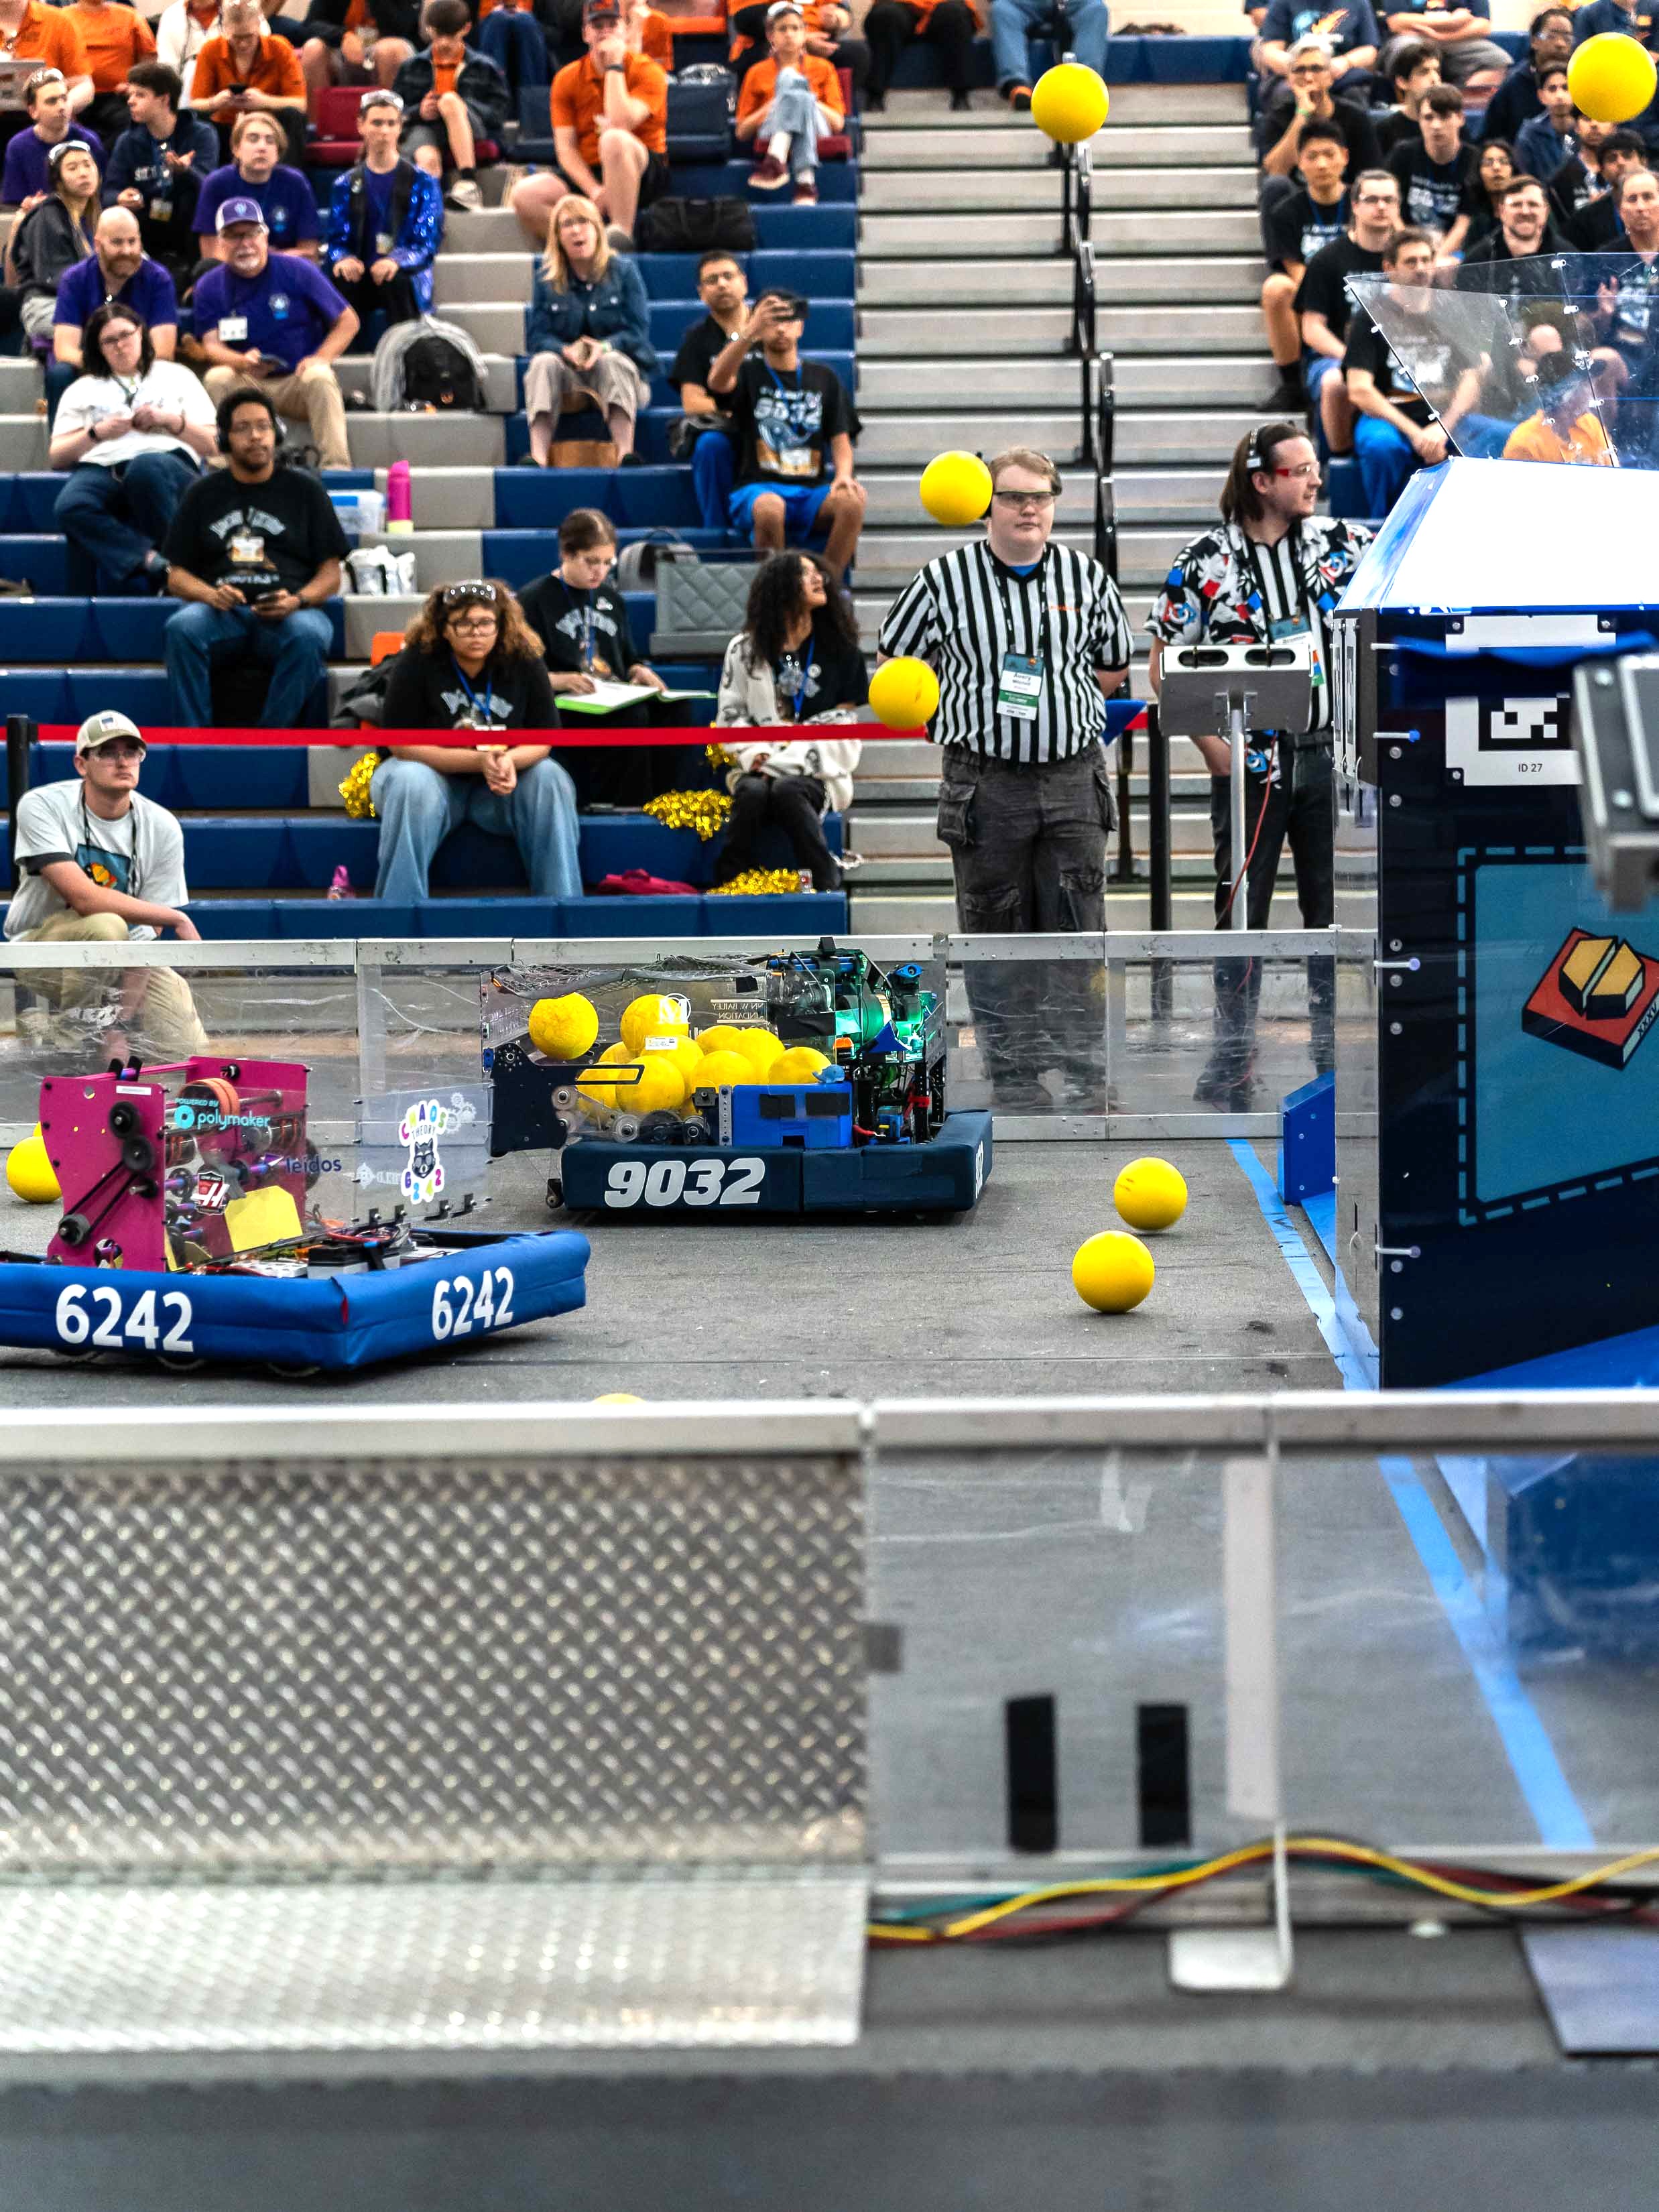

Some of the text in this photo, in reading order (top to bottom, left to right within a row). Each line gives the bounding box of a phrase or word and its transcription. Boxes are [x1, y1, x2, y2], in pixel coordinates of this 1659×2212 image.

[1518, 763, 1542, 772] ID 27
[1638, 1001, 1658, 1038] XXXV
[175, 1098, 219, 1108] POWERED BY
[198, 1109, 271, 1130] polymaker
[412, 1125, 436, 1140] THEORY
[286, 1155, 342, 1174] leidos
[405, 1168, 441, 1200] 6242
[605, 1158, 765, 1207] 9032
[432, 1266, 515, 1341] 6242
[56, 1284, 194, 1353] 6242
